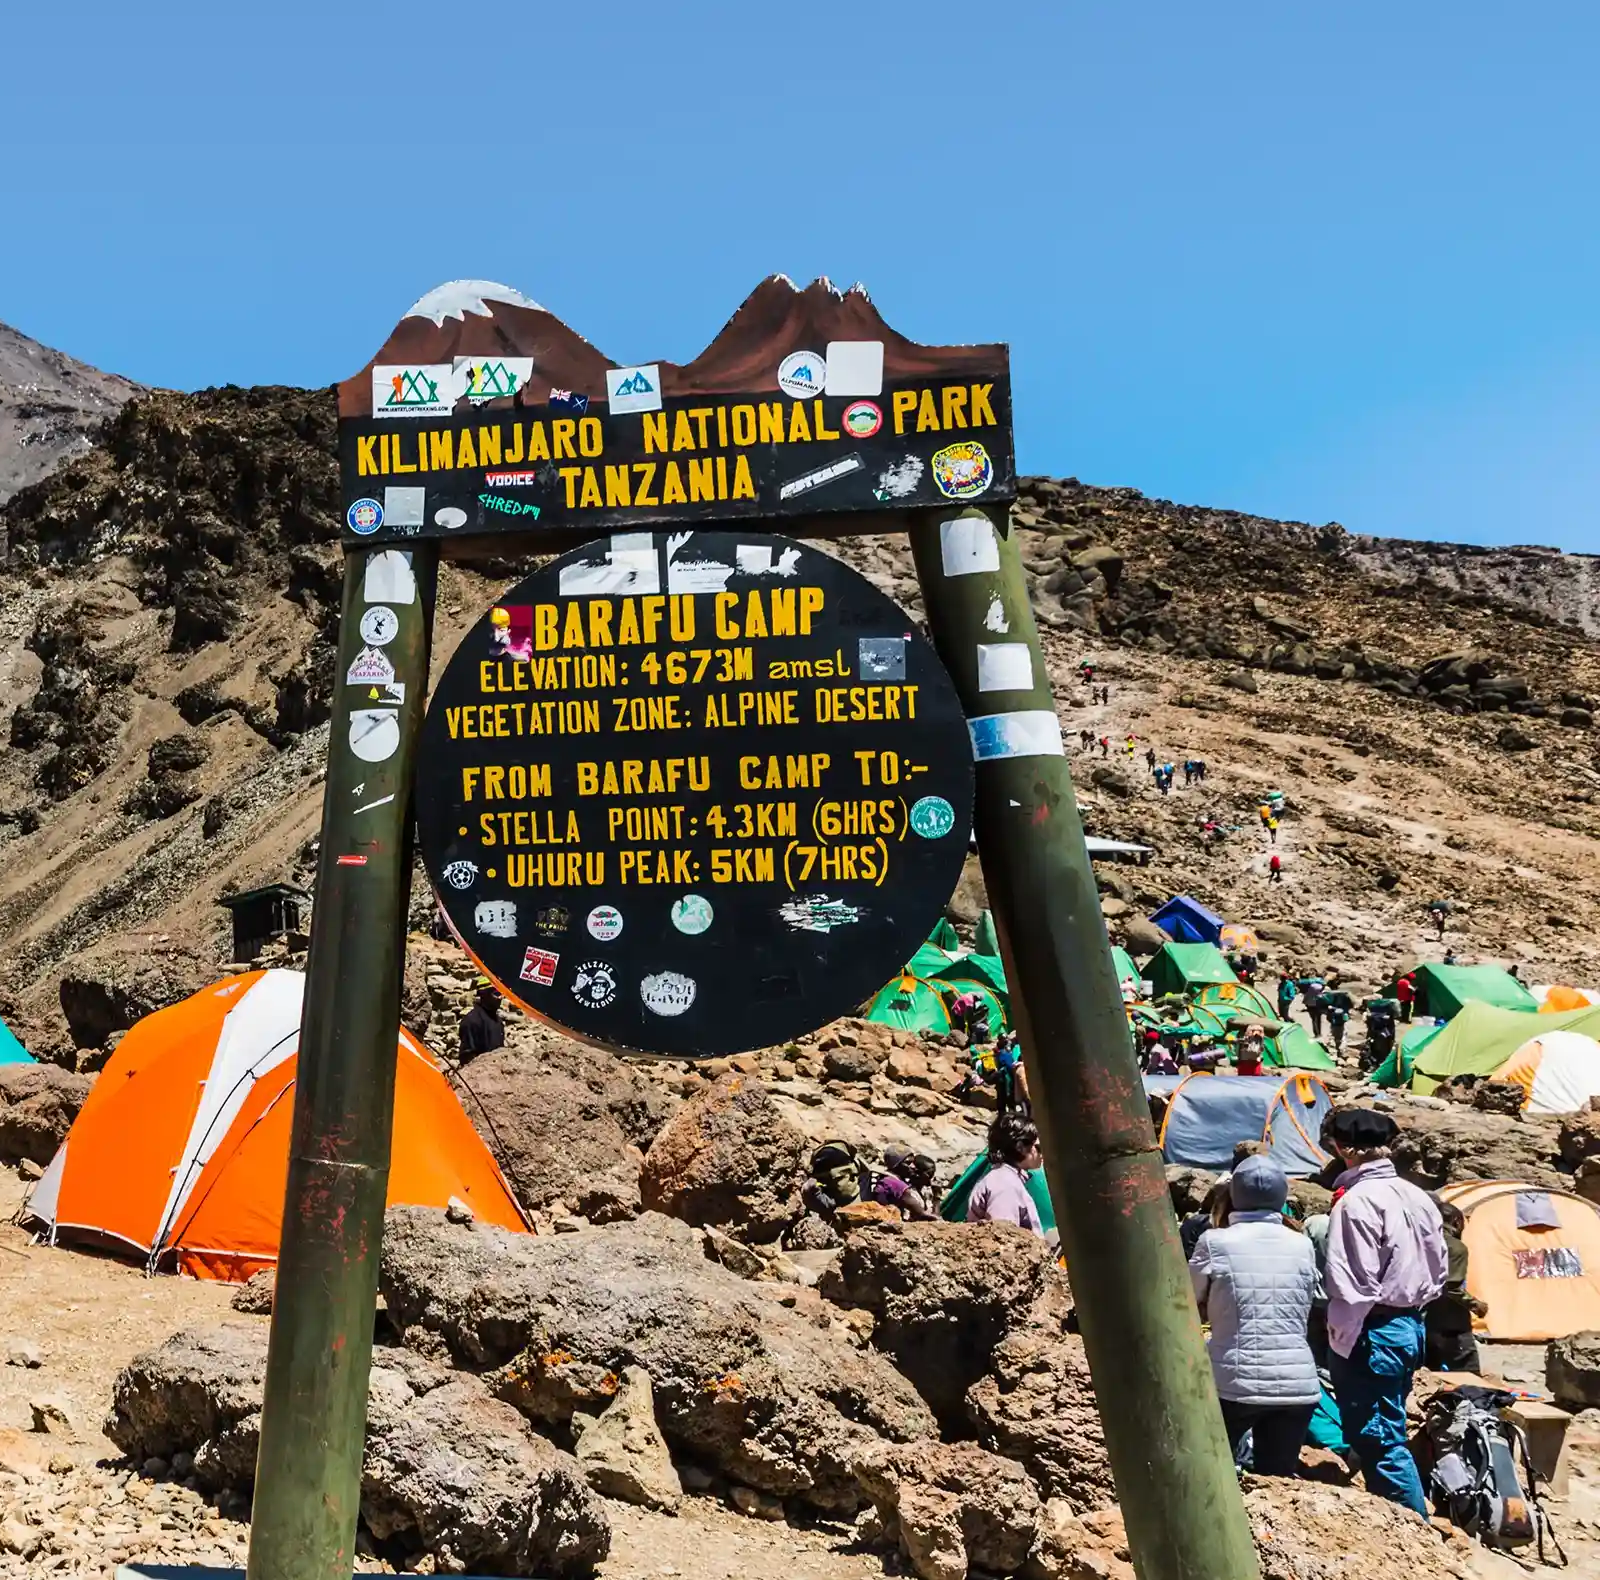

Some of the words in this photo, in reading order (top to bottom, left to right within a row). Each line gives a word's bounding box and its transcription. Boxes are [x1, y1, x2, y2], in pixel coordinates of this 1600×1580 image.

[357, 417, 604, 477] KILIMANJARO
[642, 399, 841, 454] NATIONAL
[892, 383, 998, 435] PARK
[486, 473, 534, 487] VODICE
[558, 454, 756, 509] TANZANIA
[534, 593, 696, 651] BARAFU
[714, 586, 825, 641] CAMP
[479, 653, 629, 693] ELEVATION:
[640, 646, 754, 685] 4673M
[768, 649, 851, 680] amsl
[445, 699, 600, 739] VEGETATION
[613, 695, 692, 731] ZONE:
[705, 690, 800, 728] ALPINE
[815, 685, 919, 723] DESERT
[462, 763, 553, 802] FROM
[576, 756, 711, 796] BARAFU
[739, 752, 831, 790] CAMP
[480, 810, 581, 846] STELLA
[812, 795, 909, 845] (6HRS)
[507, 850, 605, 888] UHURU
[619, 849, 700, 885] PEAK:
[711, 847, 775, 883] 5KM
[783, 836, 889, 892] (7HRS)
[525, 953, 557, 978] 72
[577, 960, 613, 974] ZELZATE
